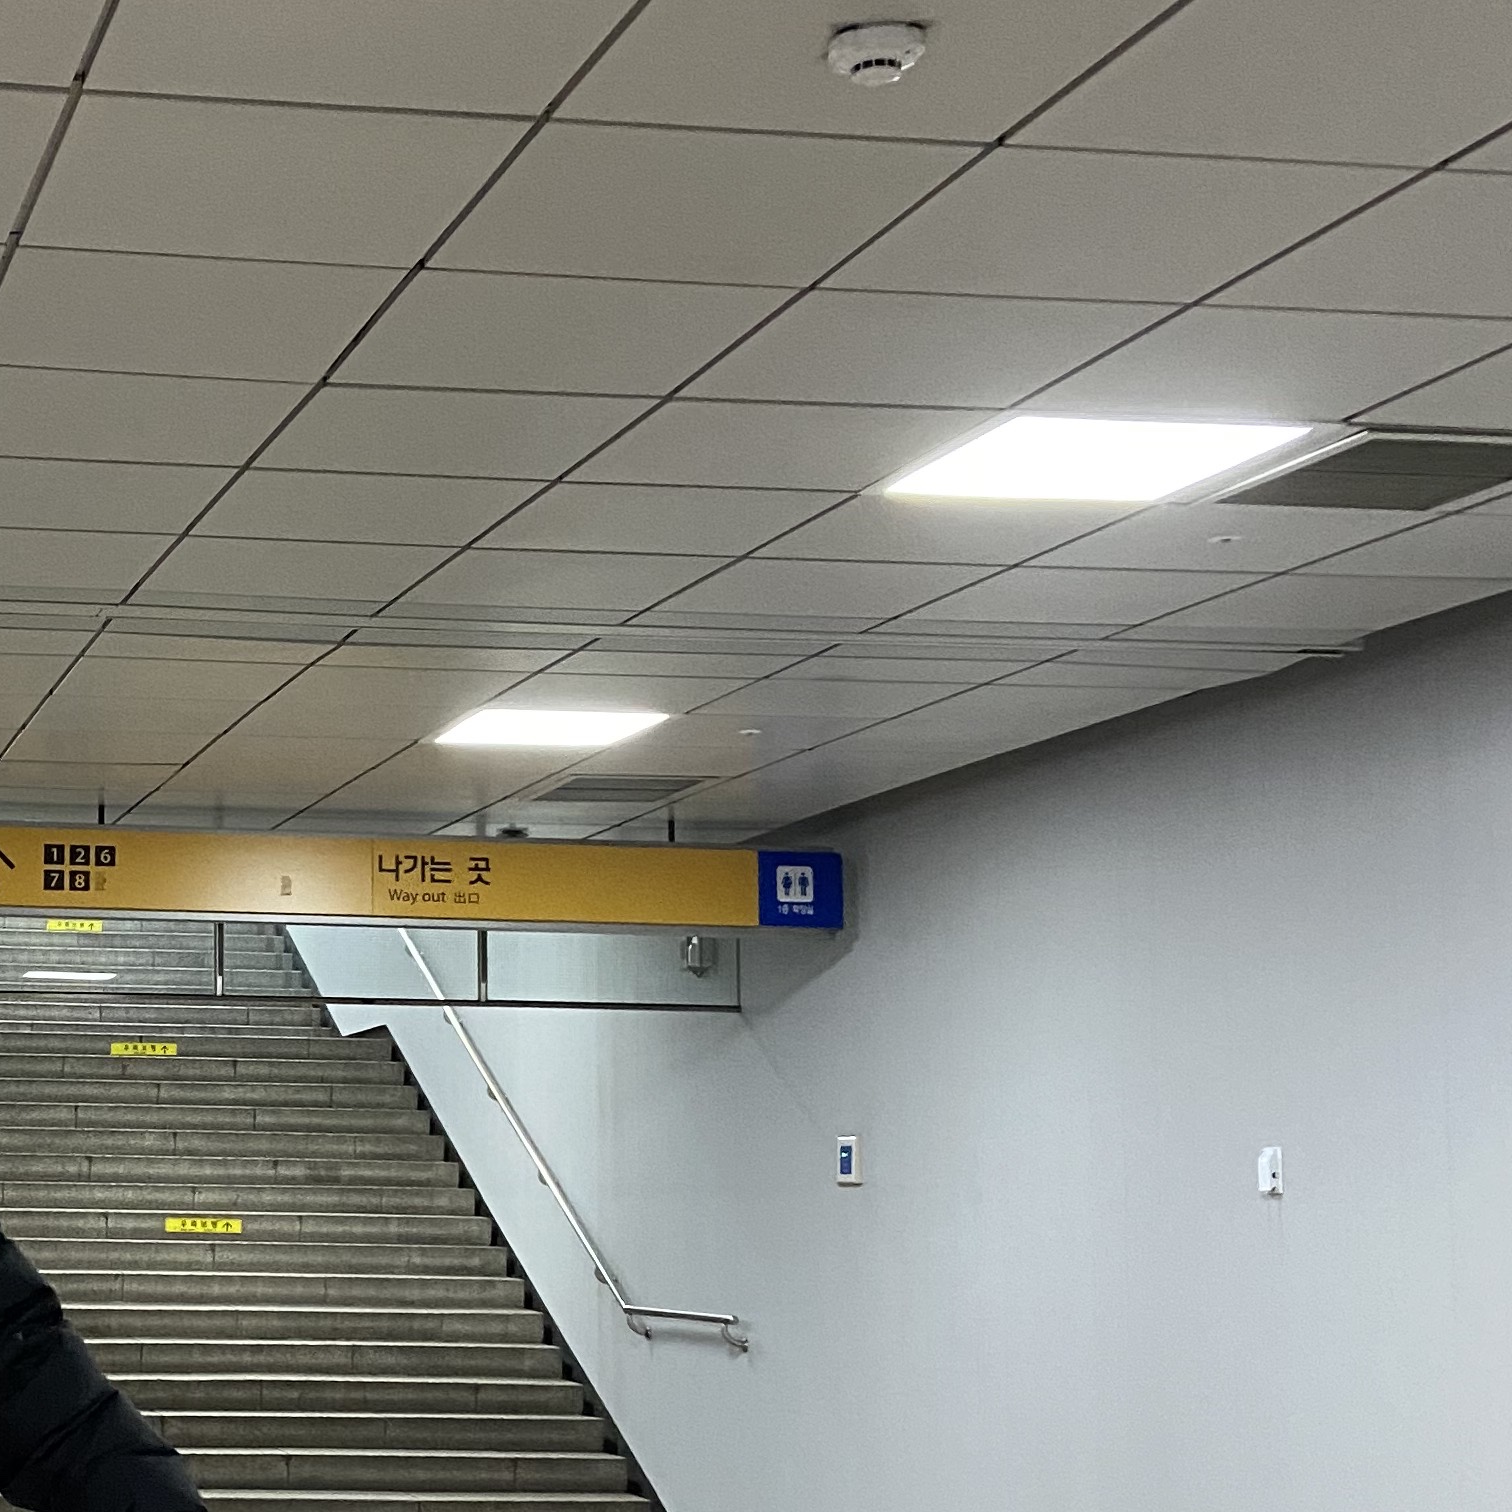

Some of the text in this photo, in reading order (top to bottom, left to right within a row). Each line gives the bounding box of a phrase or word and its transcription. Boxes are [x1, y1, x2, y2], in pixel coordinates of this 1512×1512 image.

[75, 847, 86, 863] 2
[100, 849, 112, 864] 6
[378, 854, 491, 885] 나가는 곳
[49, 872, 86, 889] 7 8
[388, 888, 481, 905] Way out 出口
